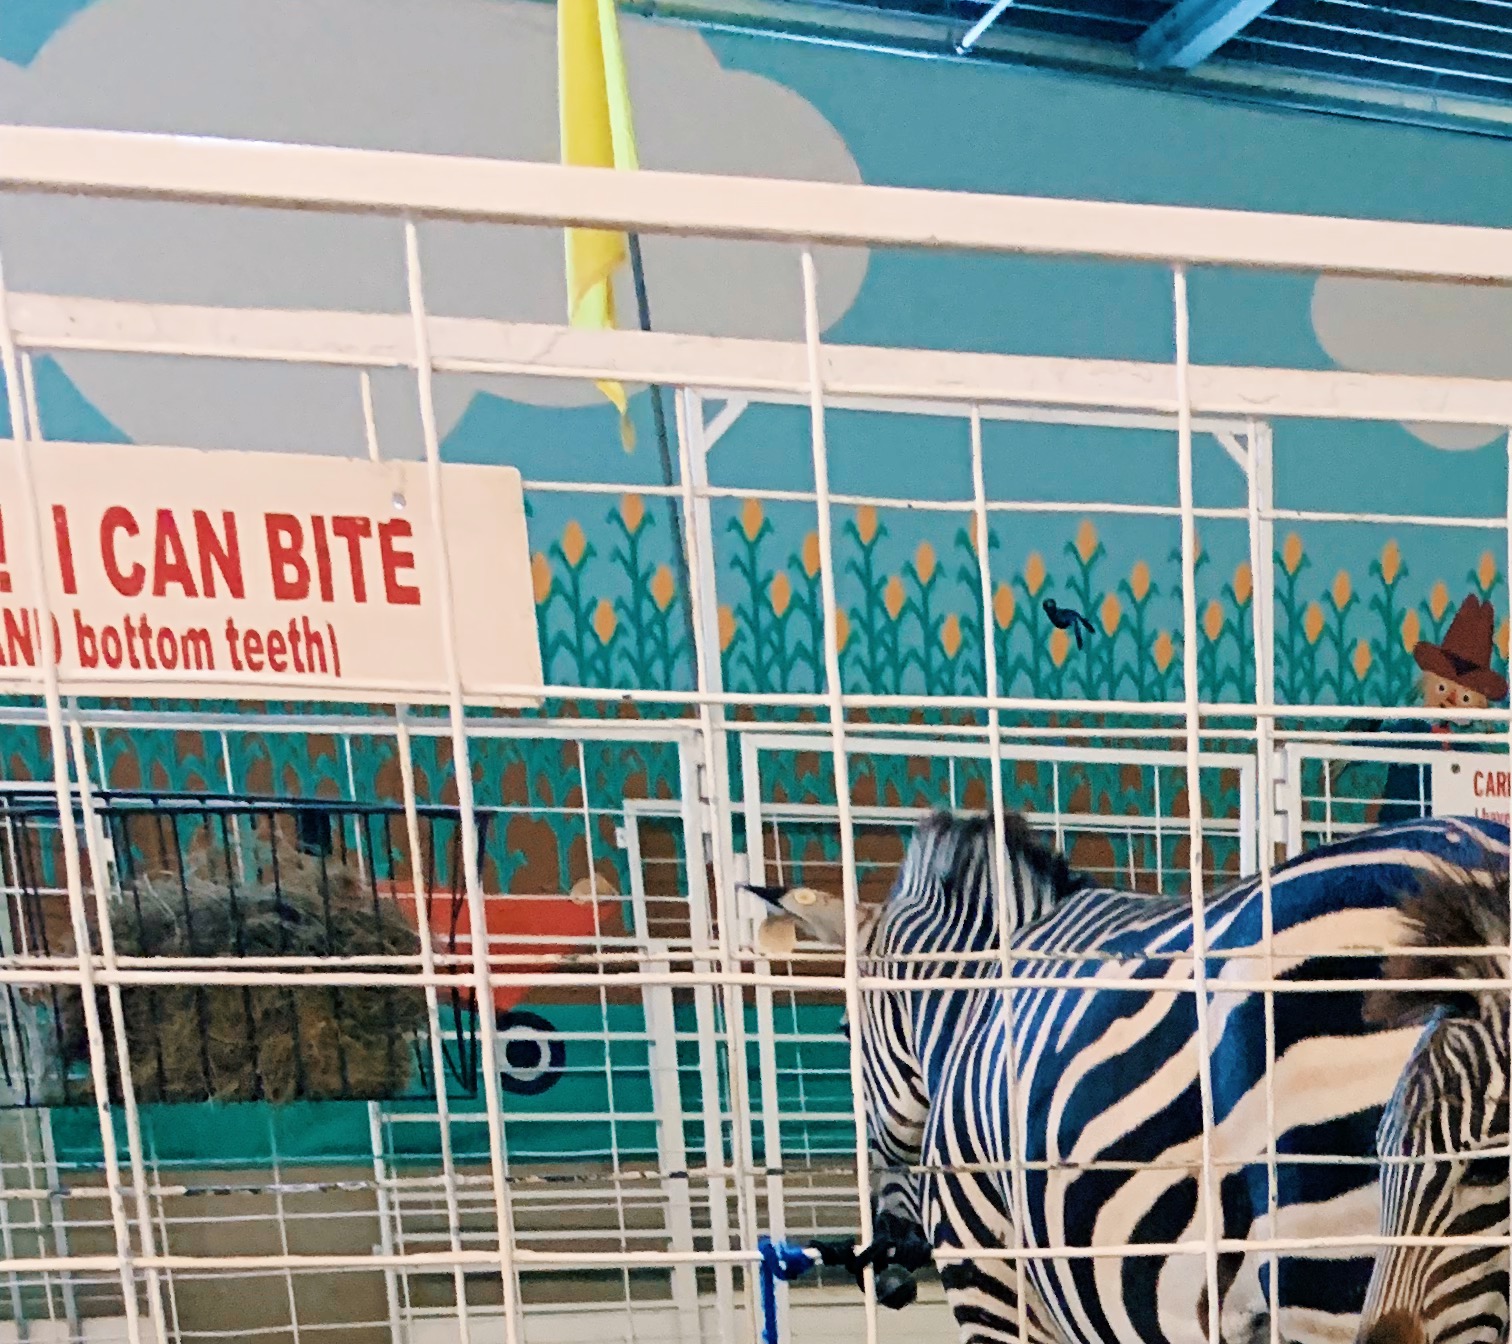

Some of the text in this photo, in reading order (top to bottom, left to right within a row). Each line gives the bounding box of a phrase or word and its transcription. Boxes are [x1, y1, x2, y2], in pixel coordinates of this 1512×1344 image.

[52, 504, 77, 594] I
[100, 505, 246, 599] CAN
[264, 512, 421, 605] BITE
[73, 608, 215, 670] bottom
[225, 615, 341, 678] teeth)
